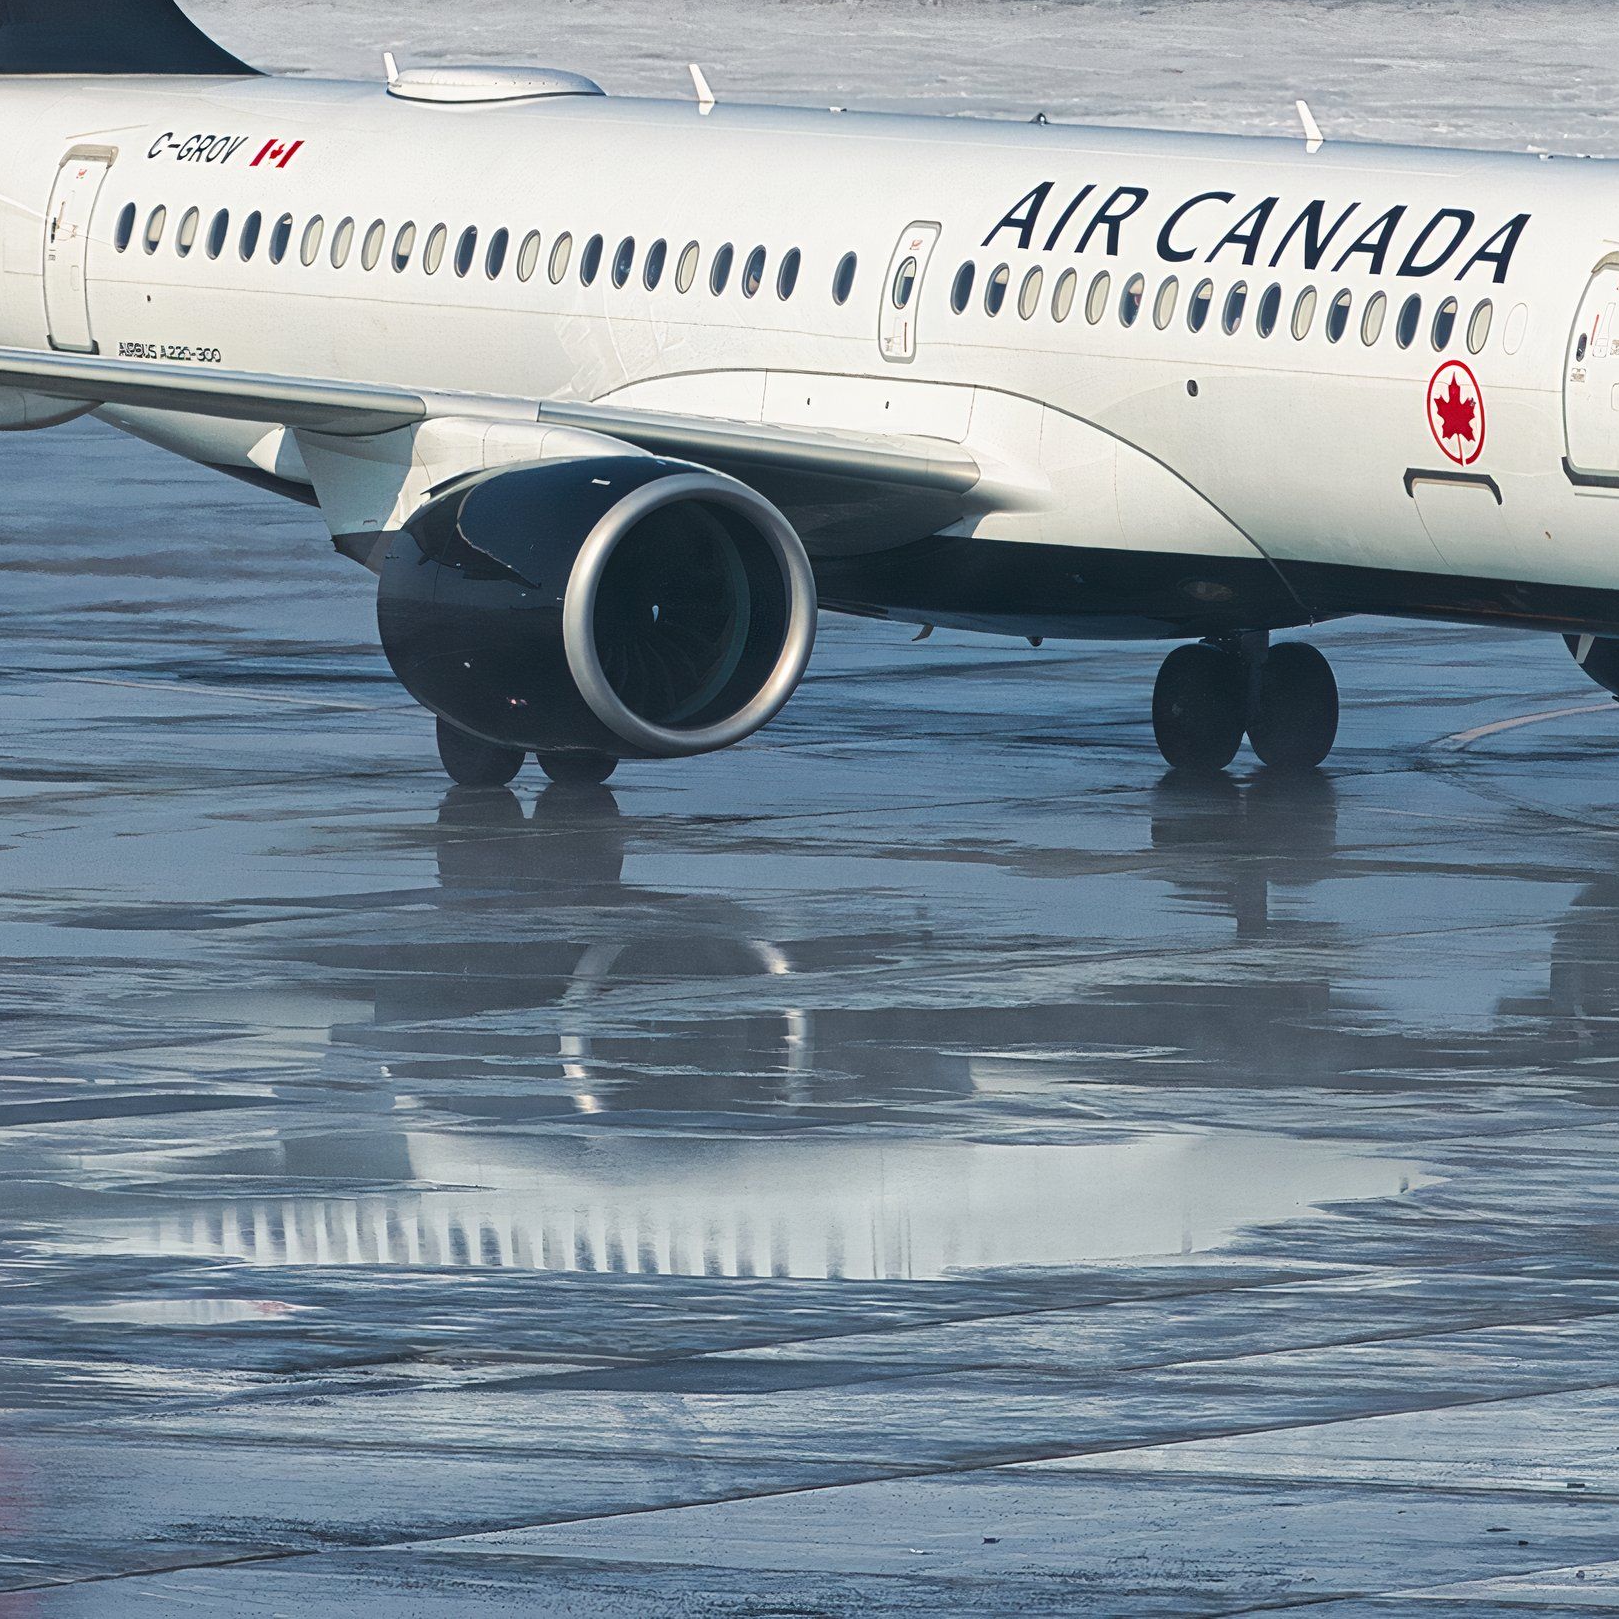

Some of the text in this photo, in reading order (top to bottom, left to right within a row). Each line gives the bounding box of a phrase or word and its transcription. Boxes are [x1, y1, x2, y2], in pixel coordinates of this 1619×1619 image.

[147, 131, 249, 164] C-GROV
[981, 181, 1532, 284] AIR CANADA
